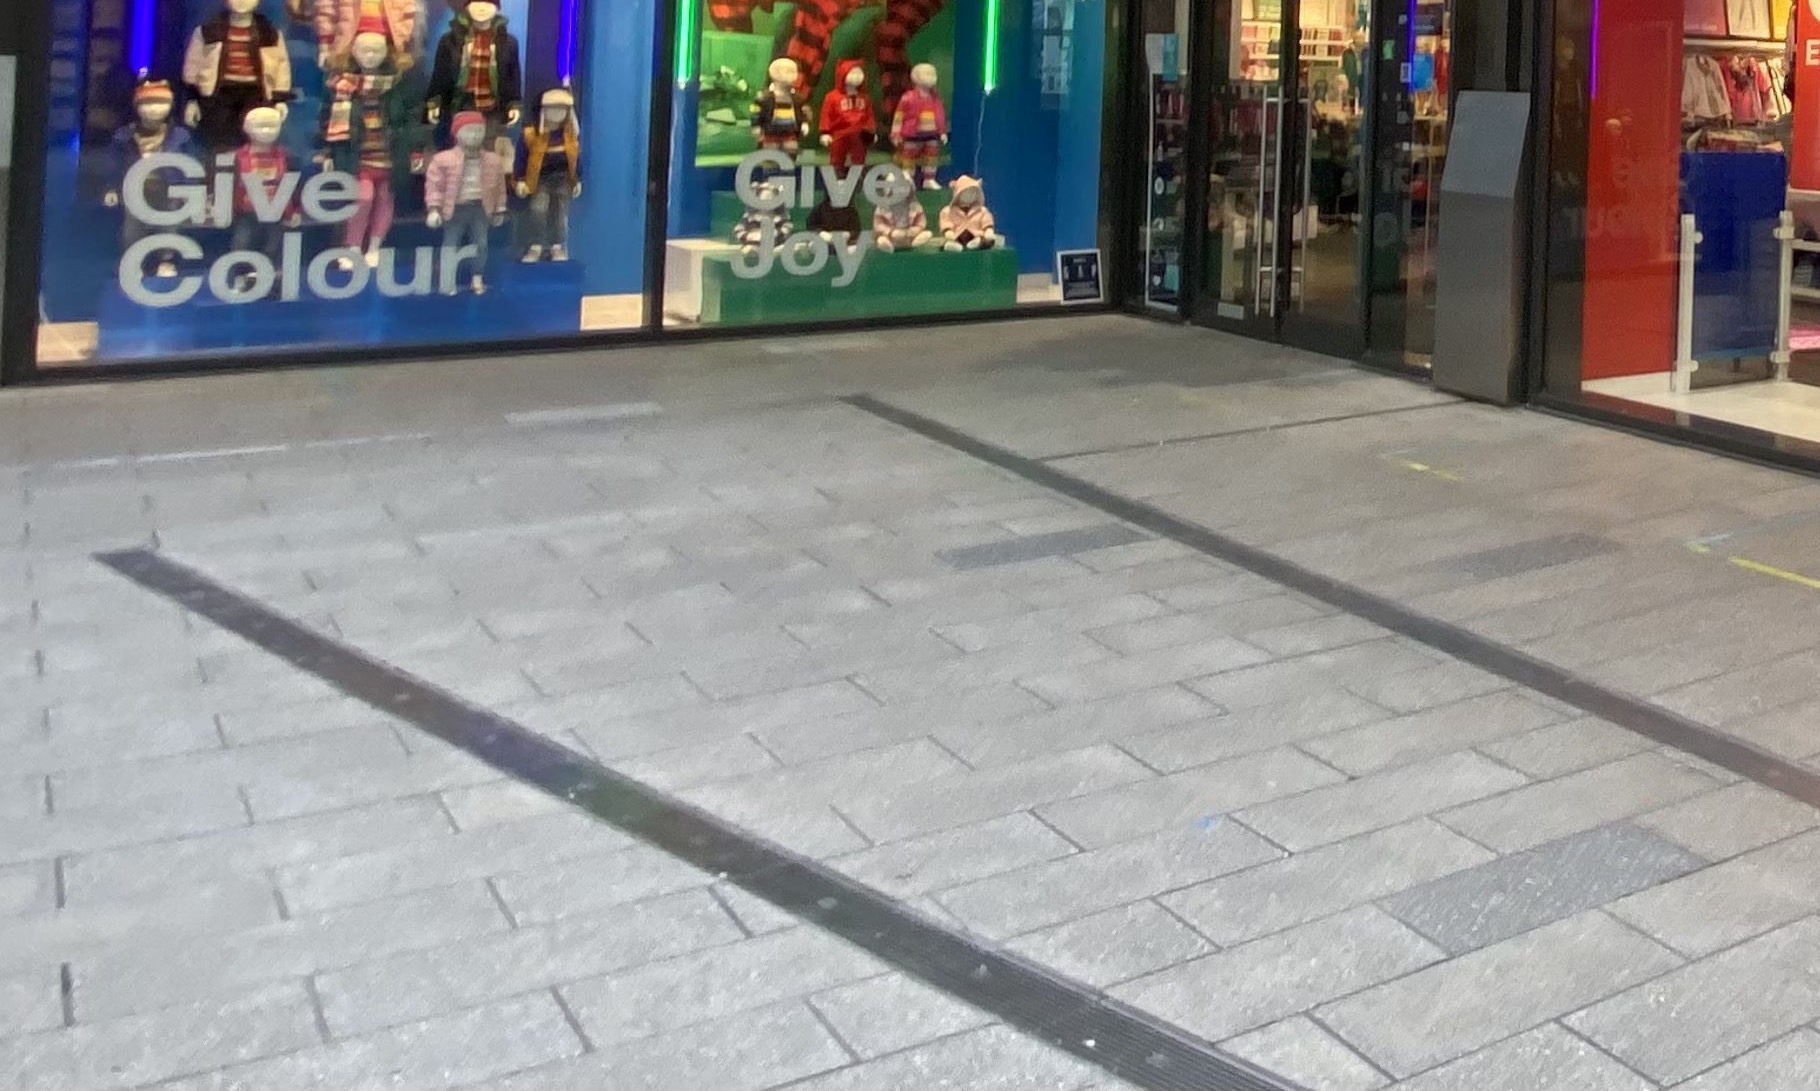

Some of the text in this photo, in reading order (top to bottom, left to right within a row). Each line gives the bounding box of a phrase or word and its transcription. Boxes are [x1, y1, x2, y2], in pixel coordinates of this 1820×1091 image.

[122, 152, 360, 229] Give
[735, 149, 911, 210] Give
[119, 231, 478, 307] Colour
[730, 214, 873, 287] Joy
